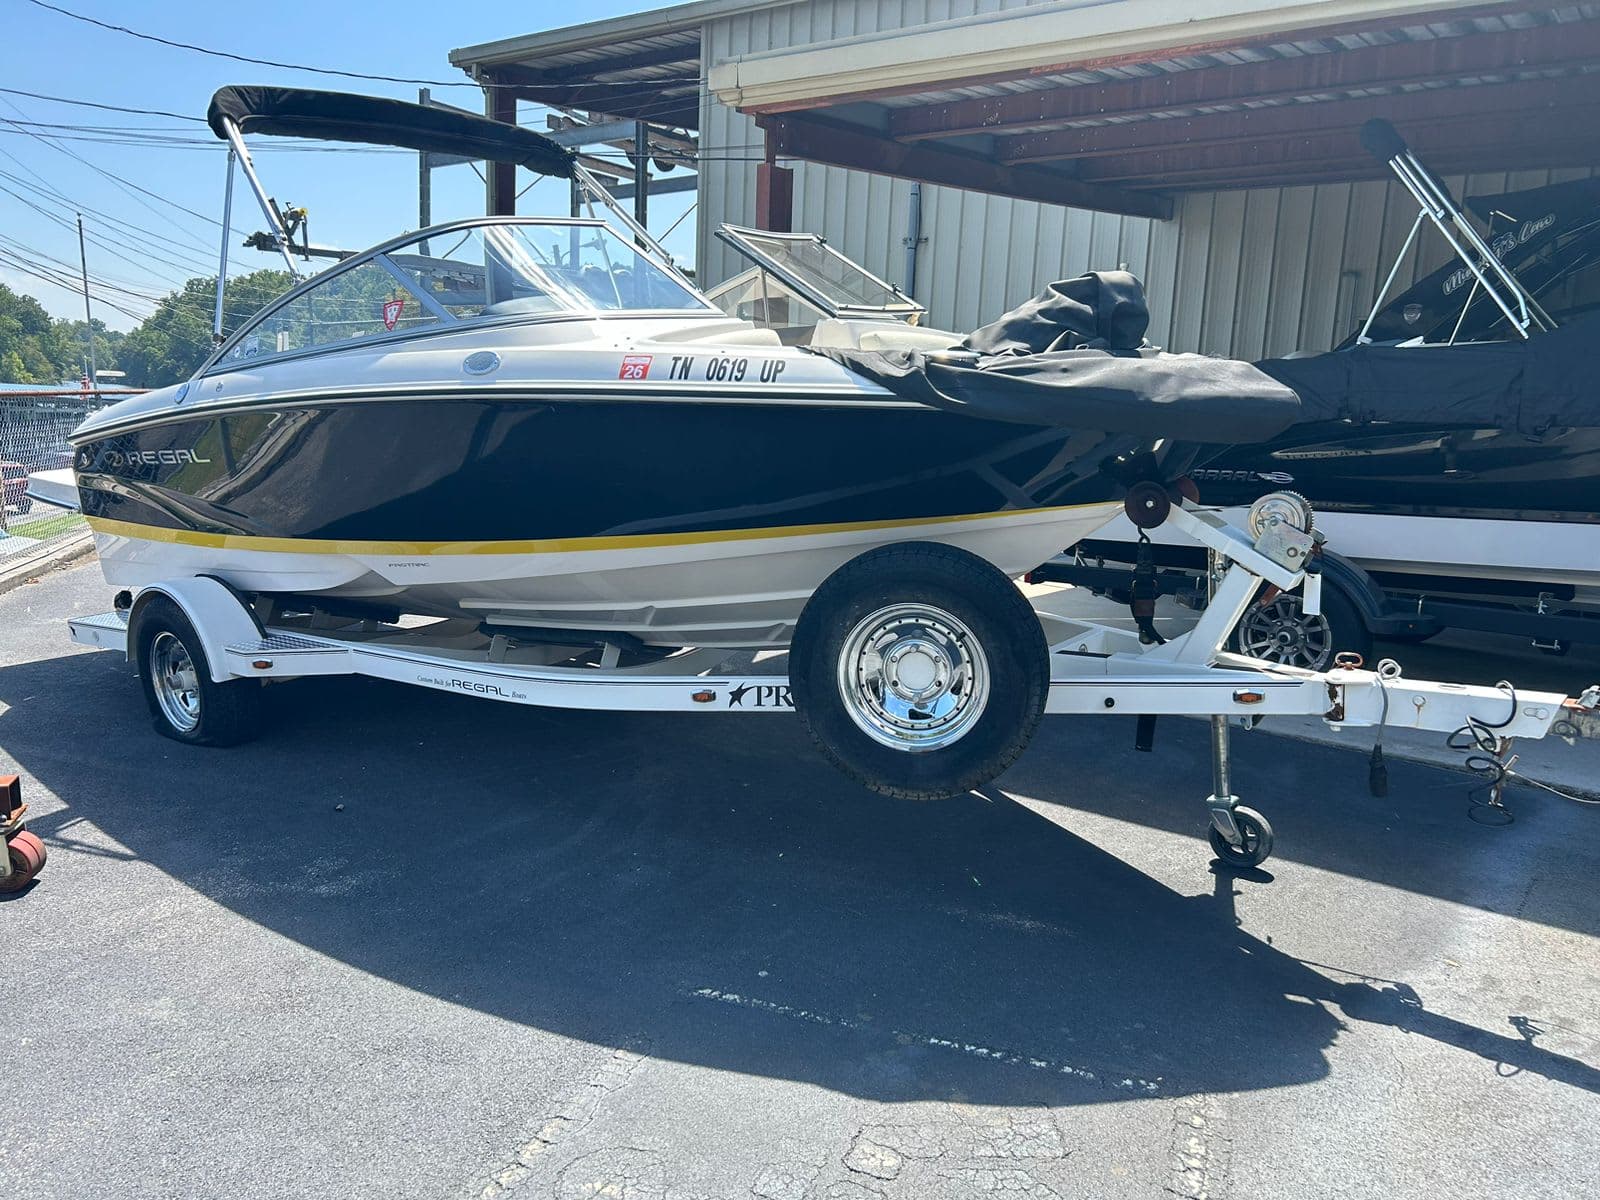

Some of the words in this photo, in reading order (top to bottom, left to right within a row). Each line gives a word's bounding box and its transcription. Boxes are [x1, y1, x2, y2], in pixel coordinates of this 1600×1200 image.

[623, 365, 643, 379] 26
[669, 357, 694, 380] TN
[705, 357, 748, 382] 0619
[760, 360, 786, 383] UP
[127, 449, 211, 465] REGAL
[452, 679, 510, 698] REGAL
